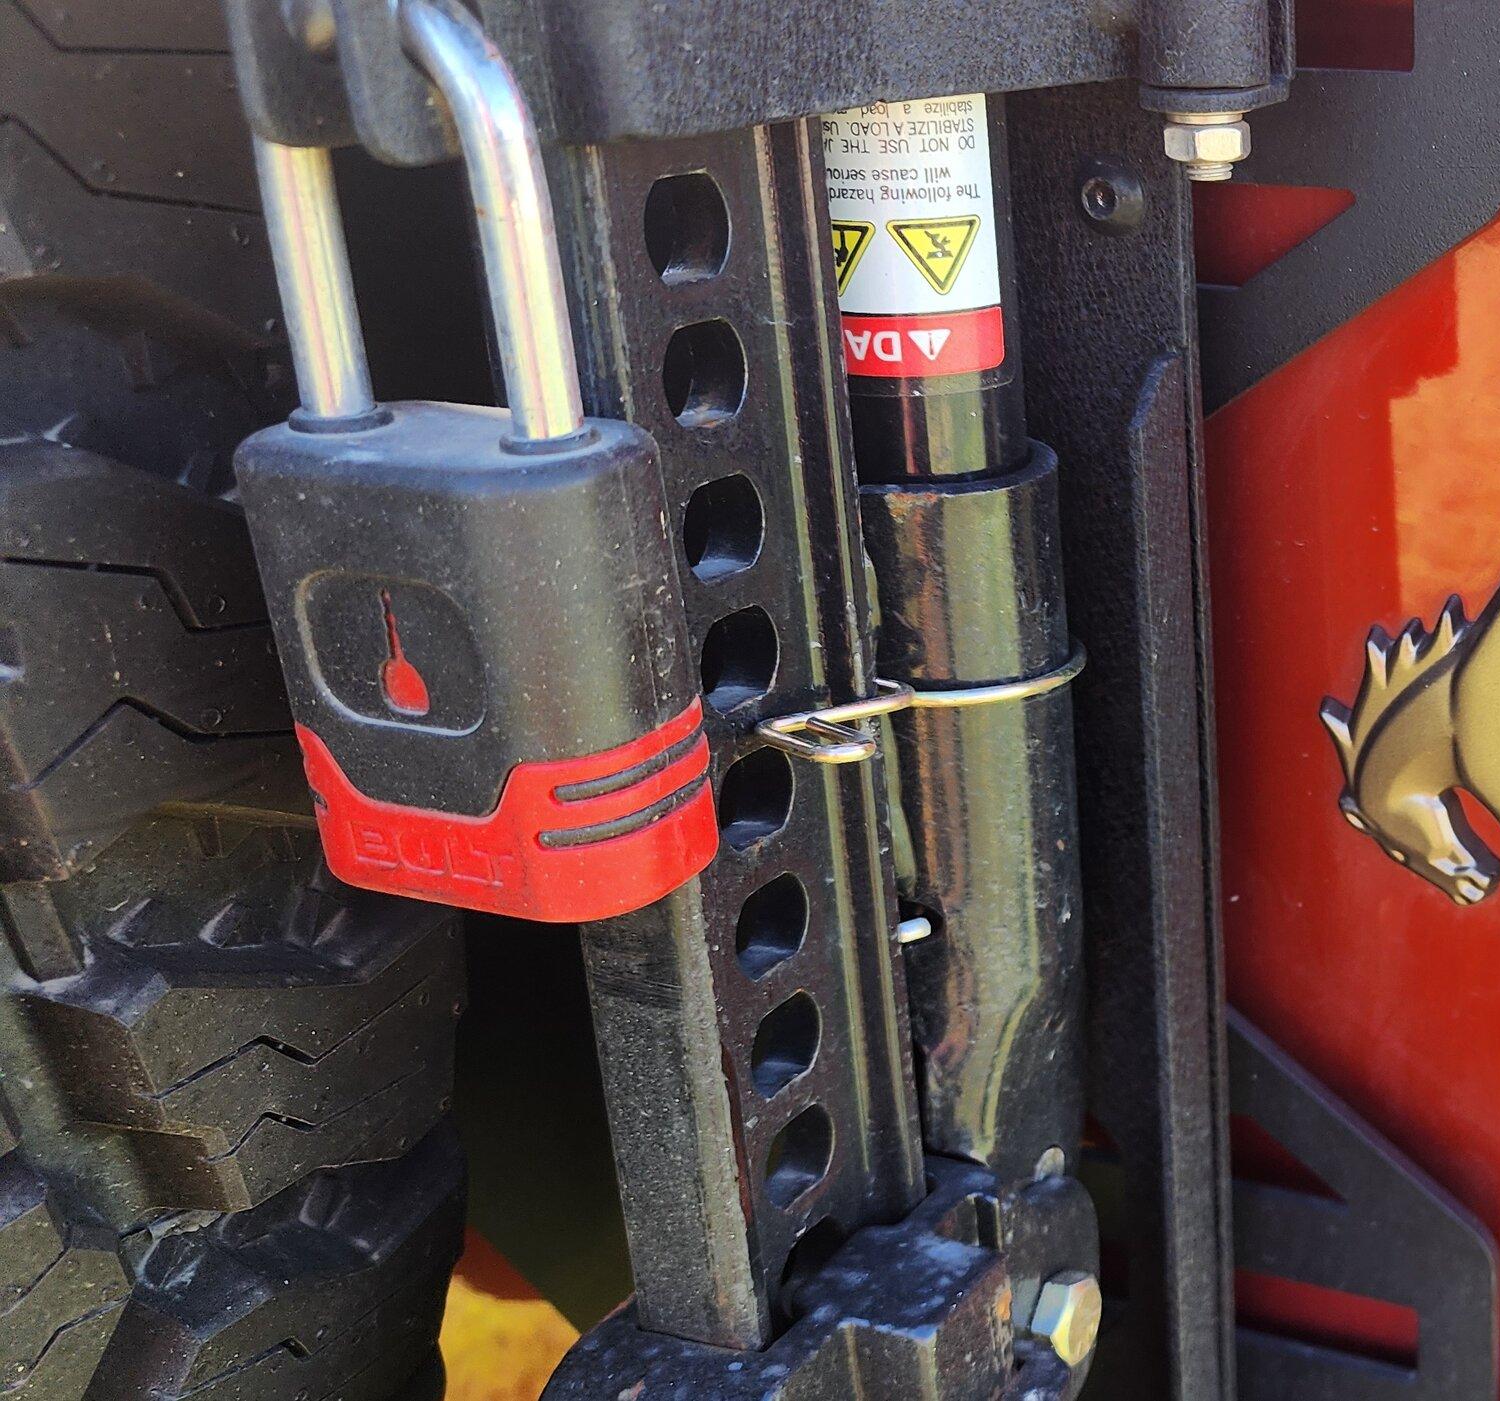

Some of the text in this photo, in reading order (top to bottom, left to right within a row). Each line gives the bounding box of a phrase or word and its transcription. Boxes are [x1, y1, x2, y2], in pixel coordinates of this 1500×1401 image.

[861, 105, 889, 118] load
[903, 104, 911, 114] a
[924, 101, 972, 117] stabilize
[847, 122, 888, 136] LOAD.
[893, 122, 903, 134] A
[909, 118, 974, 134] STABILIZE
[841, 139, 869, 153] THE
[878, 139, 909, 153] USE
[919, 138, 948, 152] NOT
[958, 135, 975, 150] DO
[872, 169, 918, 181] cause
[925, 167, 951, 183] will
[882, 186, 951, 204] following
[956, 184, 980, 199] The
[845, 330, 902, 361] DA
